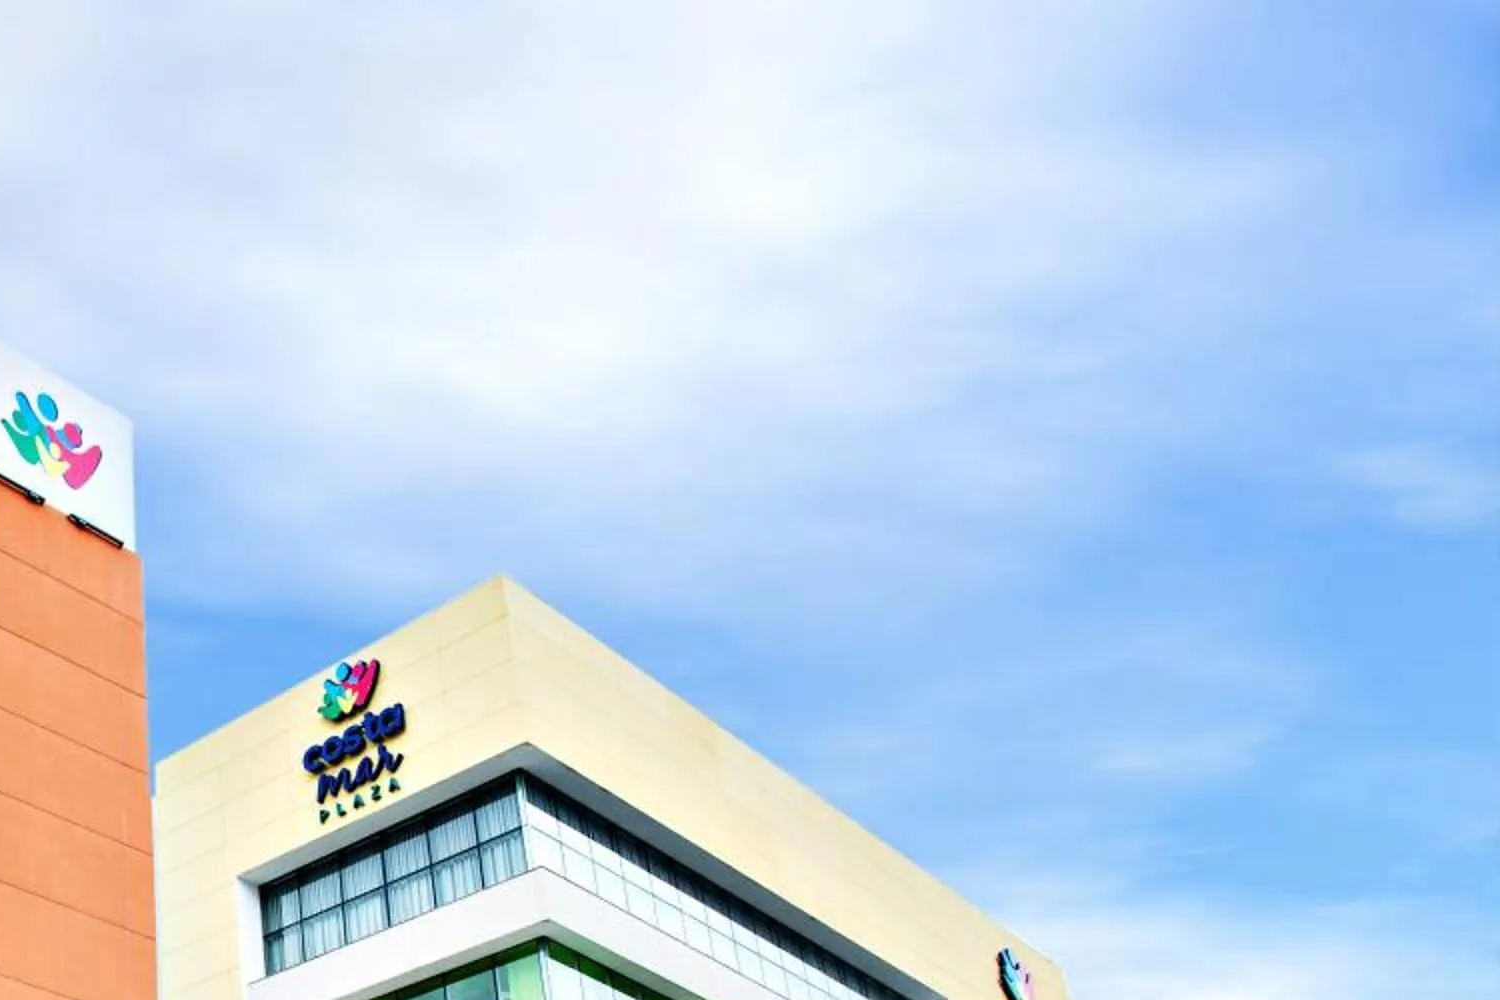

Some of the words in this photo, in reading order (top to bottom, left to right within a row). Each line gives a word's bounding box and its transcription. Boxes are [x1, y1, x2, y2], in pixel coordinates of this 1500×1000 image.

[303, 703, 406, 774] costa
[316, 742, 404, 804] mar
[319, 777, 401, 824] PLAZA
